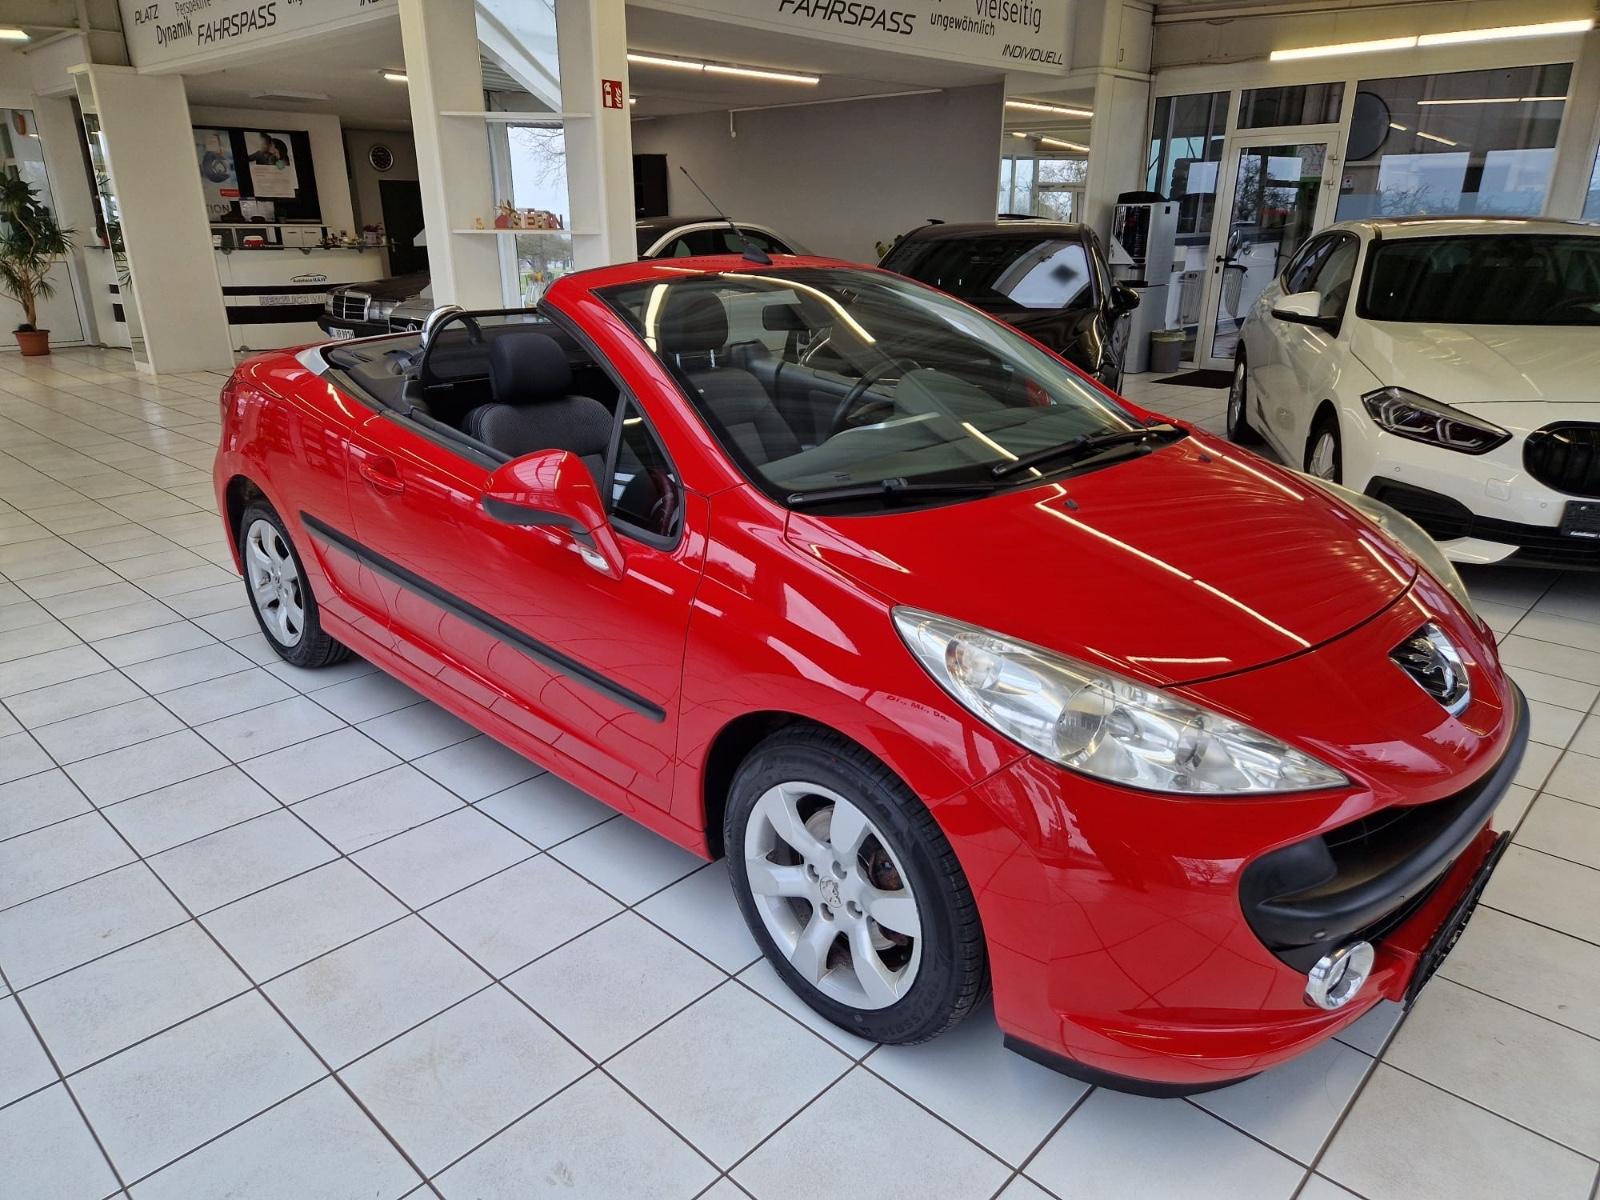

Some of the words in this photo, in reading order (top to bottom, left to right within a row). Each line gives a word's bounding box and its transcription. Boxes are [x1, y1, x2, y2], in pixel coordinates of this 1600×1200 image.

[135, 4, 159, 25] PLATZ
[198, 3, 276, 45] FAHRSPASS
[778, 0, 917, 35] FAHRSPASS
[930, 12, 996, 36] ungewöhnlich
[156, 17, 193, 47] Dynamik
[1002, 44, 1064, 65] INDIVIDUELL
